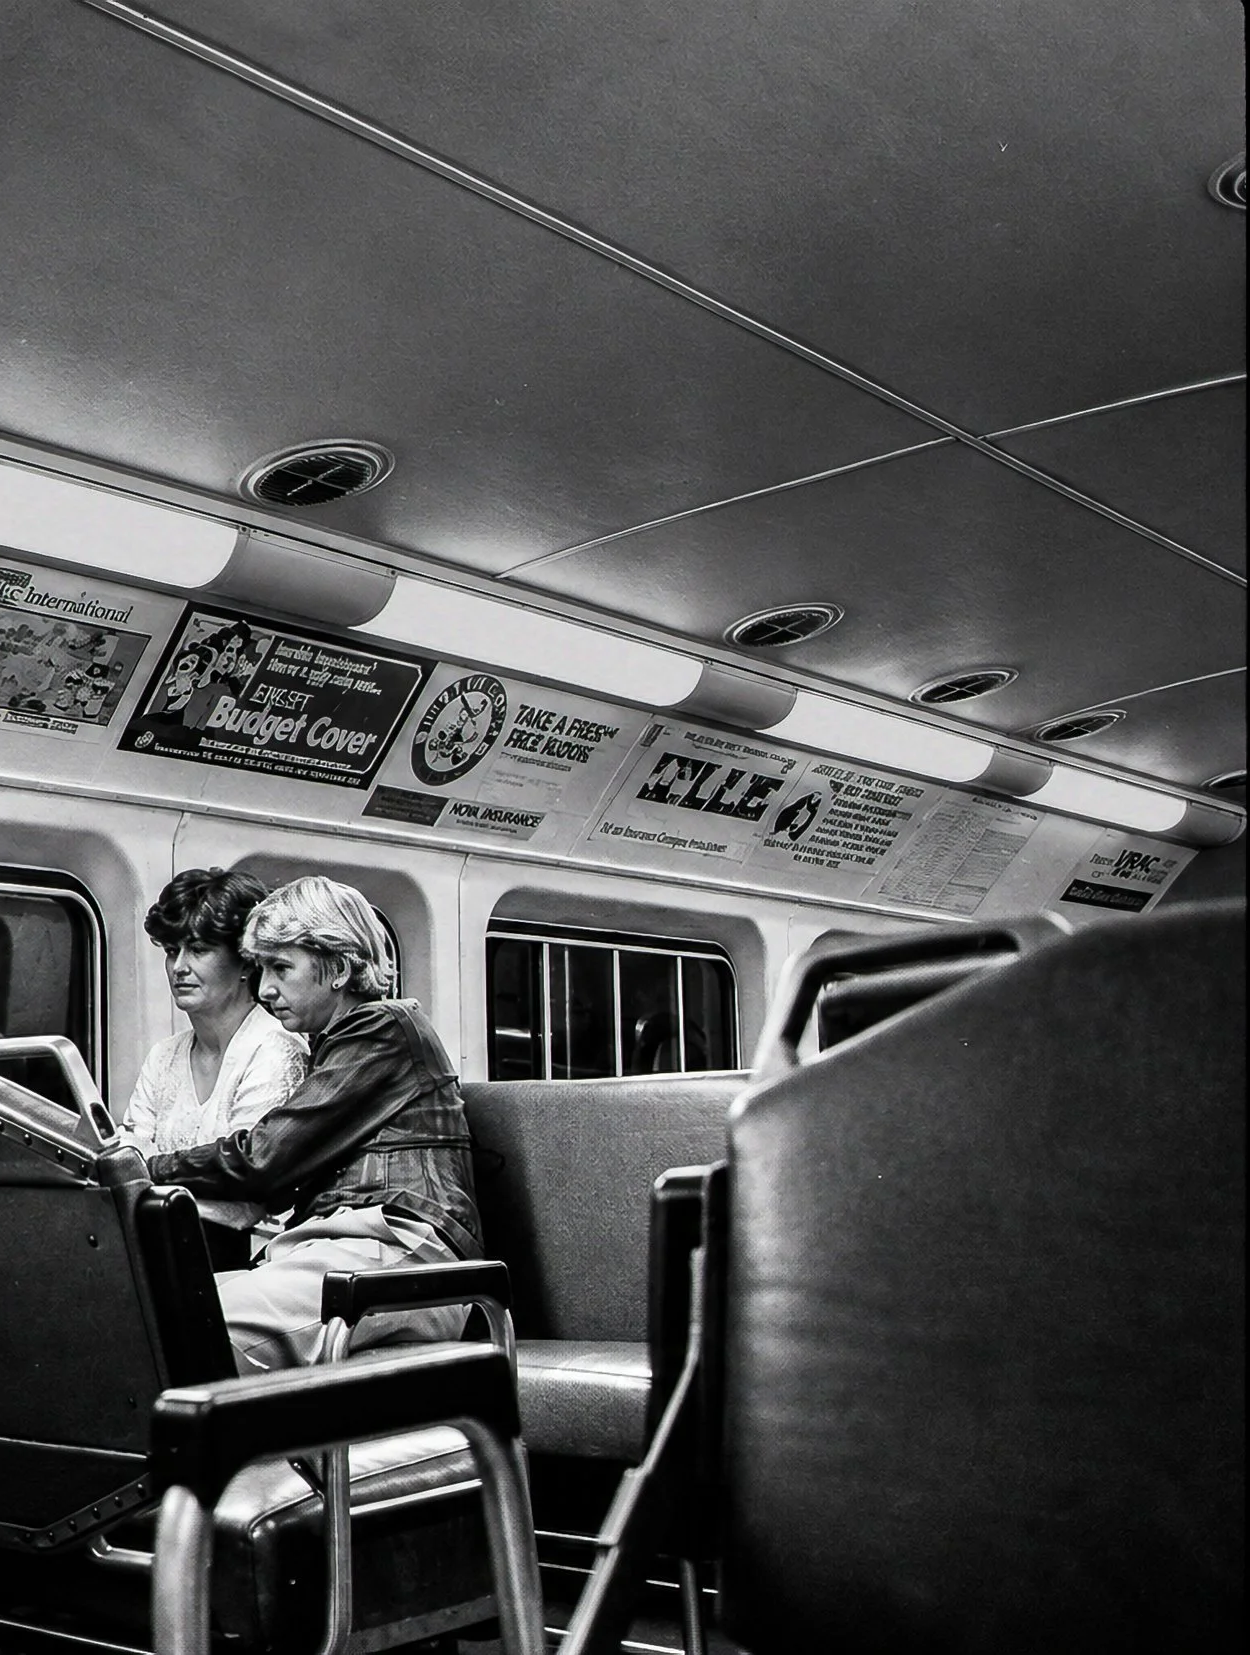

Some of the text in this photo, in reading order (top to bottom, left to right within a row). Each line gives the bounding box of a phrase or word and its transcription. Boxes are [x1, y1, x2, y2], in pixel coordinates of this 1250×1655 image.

[24, 586, 134, 624] International
[206, 695, 308, 745] Budget
[307, 716, 378, 756] Cover
[513, 704, 557, 731] TAKE
[551, 715, 568, 735] A
